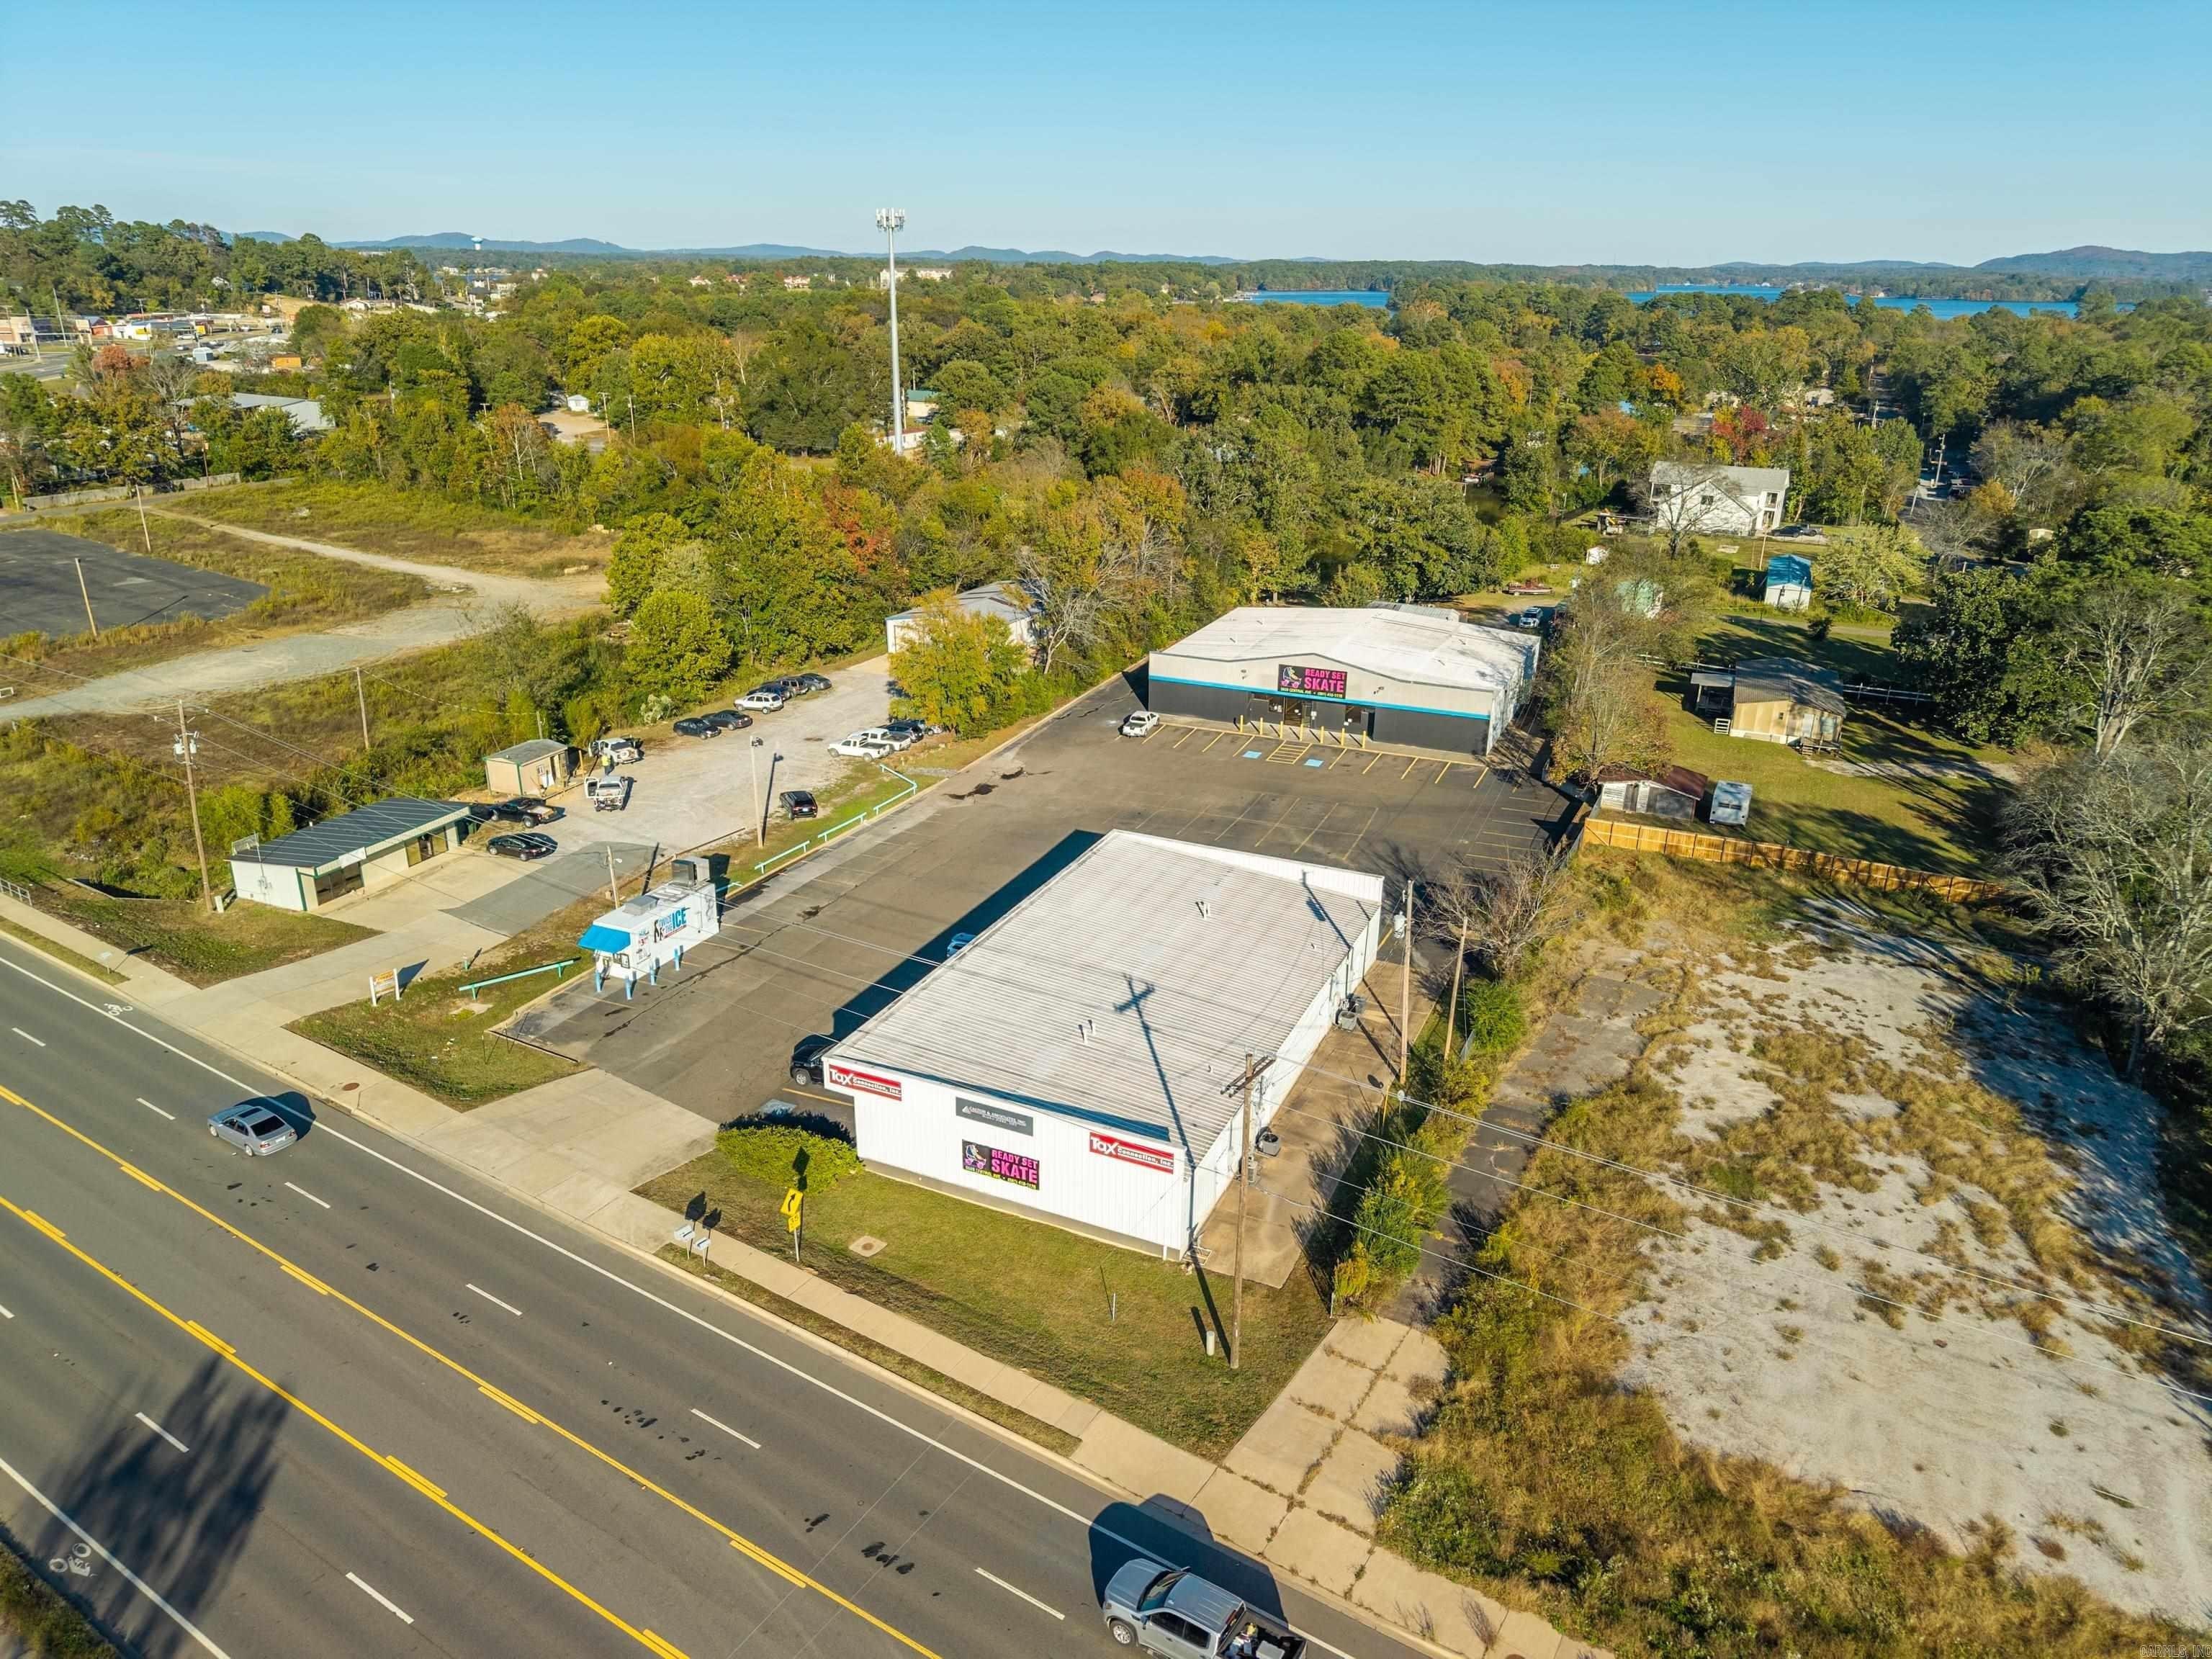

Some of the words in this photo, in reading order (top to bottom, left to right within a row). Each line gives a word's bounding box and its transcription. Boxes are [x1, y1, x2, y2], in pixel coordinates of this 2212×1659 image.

[1305, 668, 1330, 678] READY
[1331, 671, 1346, 680] SET
[1304, 677, 1345, 693] SKATE
[672, 907, 687, 929] ICE
[830, 1069, 854, 1085] Tax
[1090, 1136, 1119, 1155] Tax
[992, 1149, 1020, 1164] READY
[1021, 1157, 1038, 1169] SET
[991, 1159, 1038, 1184] SKATE
